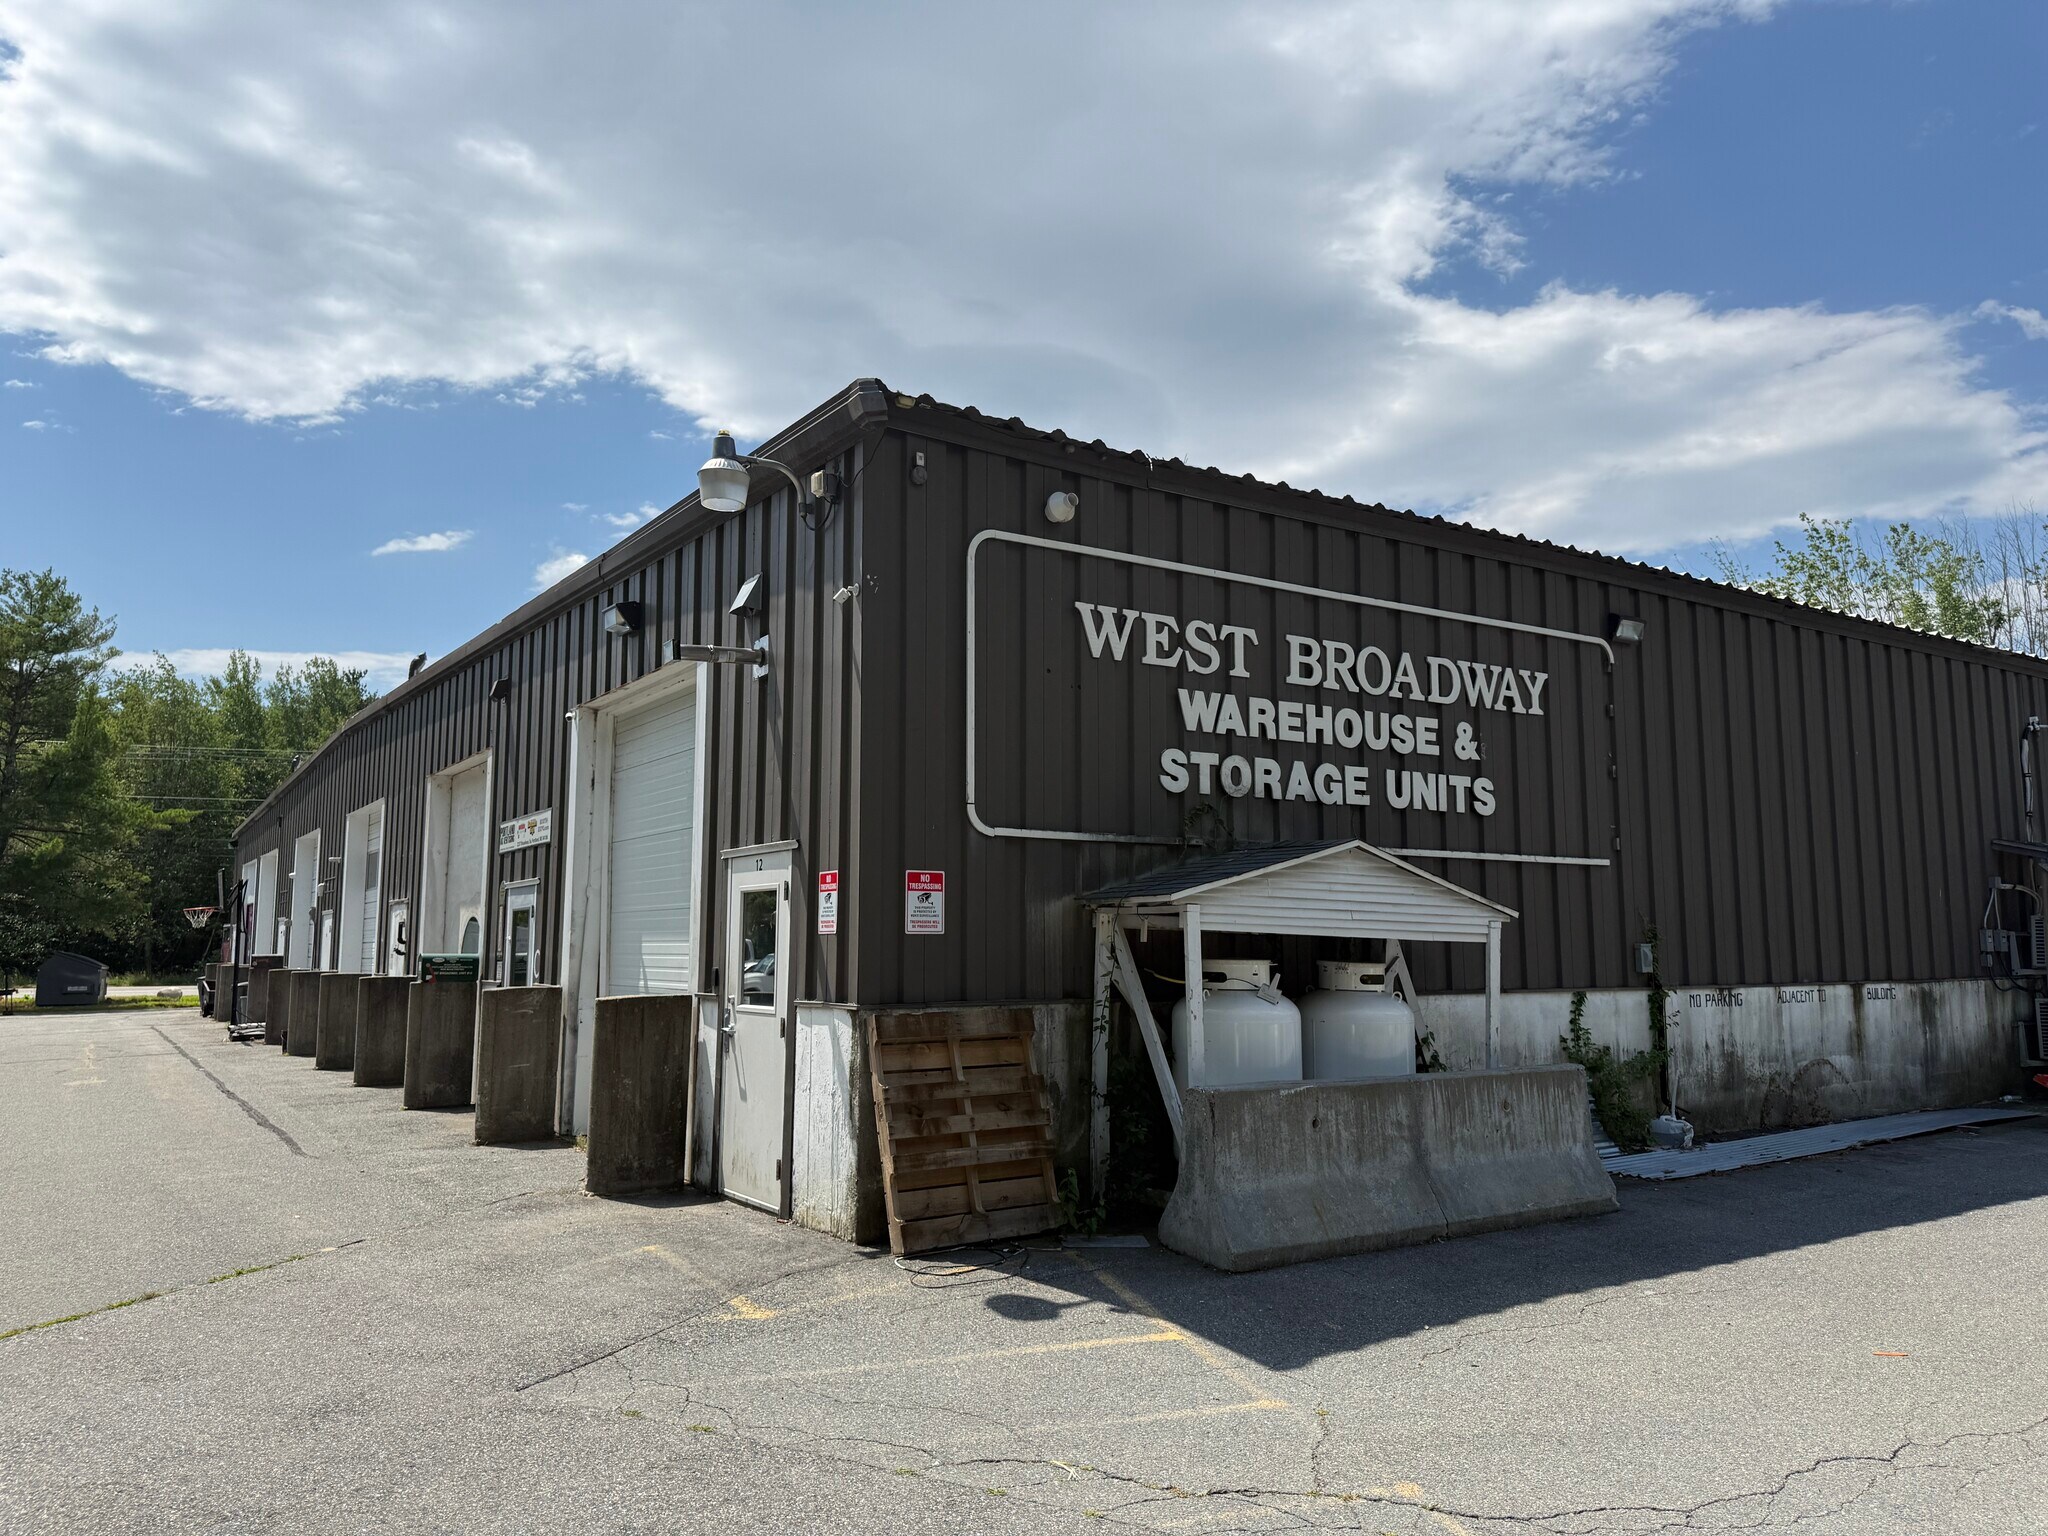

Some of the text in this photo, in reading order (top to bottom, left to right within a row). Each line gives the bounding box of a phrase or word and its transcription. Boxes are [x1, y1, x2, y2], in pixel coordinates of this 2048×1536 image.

[1075, 601, 1548, 716] WEST BROADWAY
[1178, 688, 1480, 760] WAREHOUSE &
[1159, 748, 1496, 816] STORAGE UNITS
[755, 858, 763, 872] 12
[909, 882, 942, 891] TRESPASSING
[920, 873, 931, 883] NO
[1689, 994, 1702, 1008] NO
[1705, 992, 1743, 1008] PARKING
[1777, 989, 1815, 1004] ADJACENT
[1817, 988, 1826, 1003] TO
